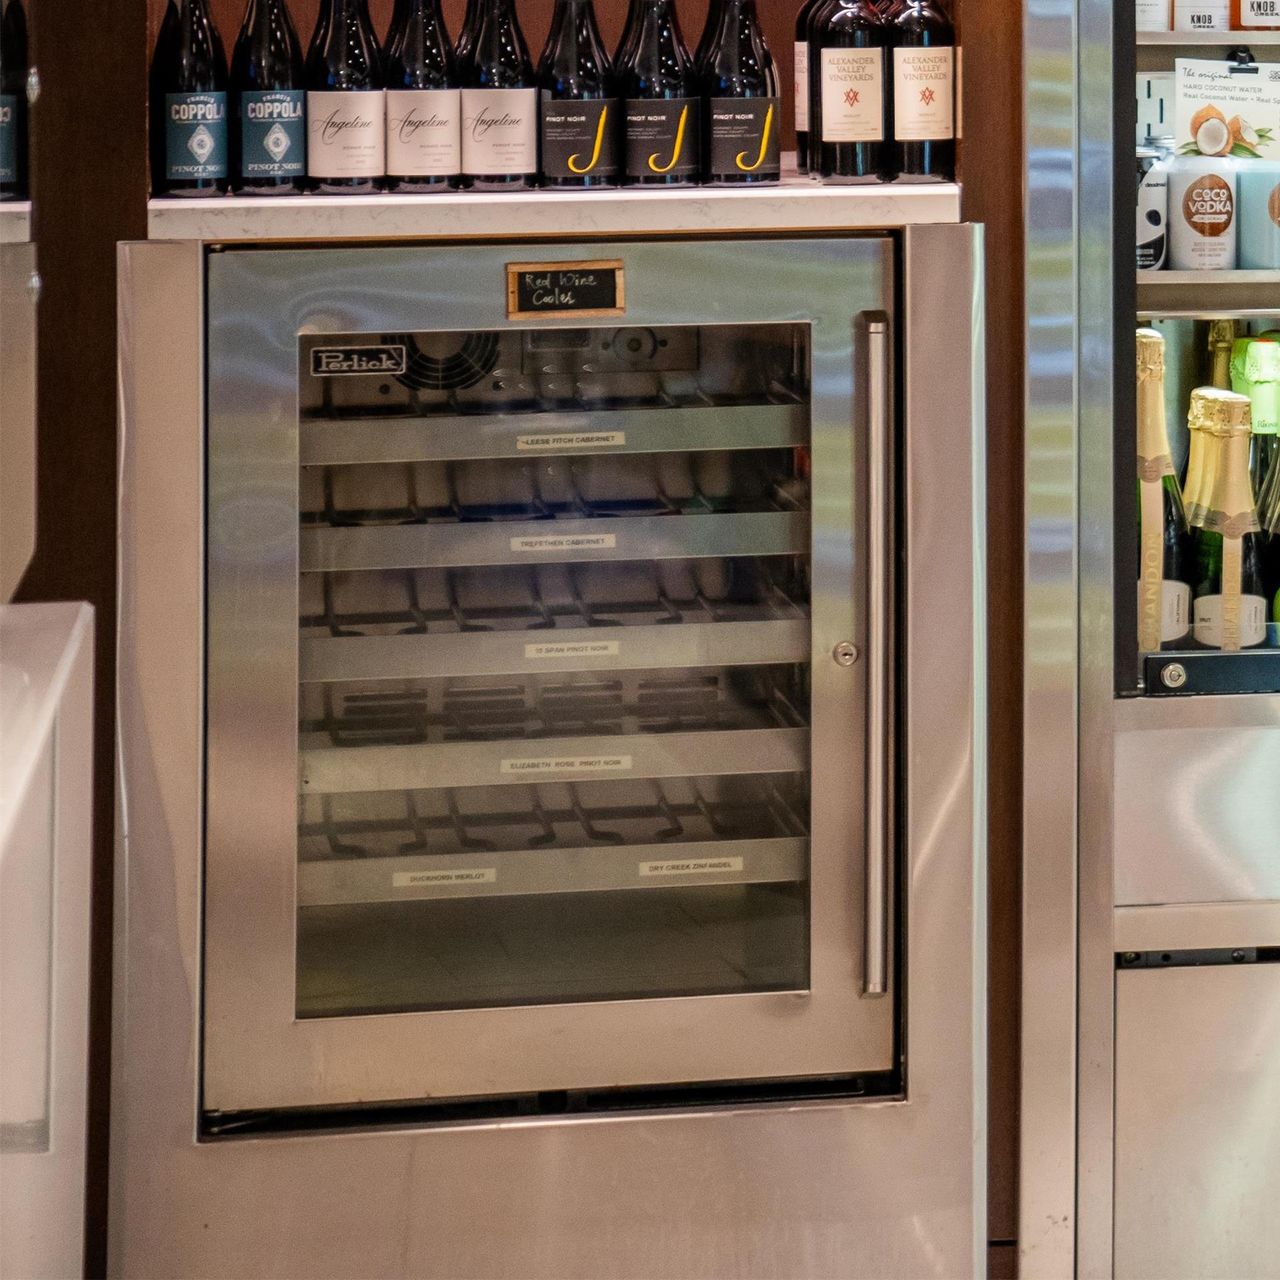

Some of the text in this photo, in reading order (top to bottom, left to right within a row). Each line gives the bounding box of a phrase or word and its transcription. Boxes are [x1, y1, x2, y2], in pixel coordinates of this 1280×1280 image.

[1249, 0, 1276, 12] KNOB
[1190, 13, 1213, 25] KNOB
[828, 57, 875, 65] ALEXANDER
[837, 65, 867, 73] VALLEY
[911, 64, 940, 72] VALLEY
[1182, 67, 1198, 78] The
[829, 74, 874, 82] VINEYARDS
[1183, 84, 1263, 94] HARD COCONUT WATER
[1183, 92, 1198, 100] Real
[1199, 93, 1228, 102] Coconut
[1229, 95, 1249, 103] Water
[1256, 96, 1271, 104] Real
[171, 103, 225, 120] COPPOLA
[247, 102, 303, 119] COPPOLA
[312, 108, 373, 145] Angeline
[391, 107, 450, 144] Angeline
[466, 106, 523, 143] Angeline
[1192, 188, 1228, 201] COCO
[1188, 200, 1232, 214] VODKA
[525, 272, 598, 290] Red Wine
[318, 352, 399, 372] Perlick
[552, 437, 574, 445] FITCH
[575, 435, 616, 444] CABERNET
[565, 538, 606, 546] CABERNET
[1143, 533, 1160, 651] CHANDON
[511, 761, 552, 770] ELIZABETH
[649, 864, 664, 872] DRY
